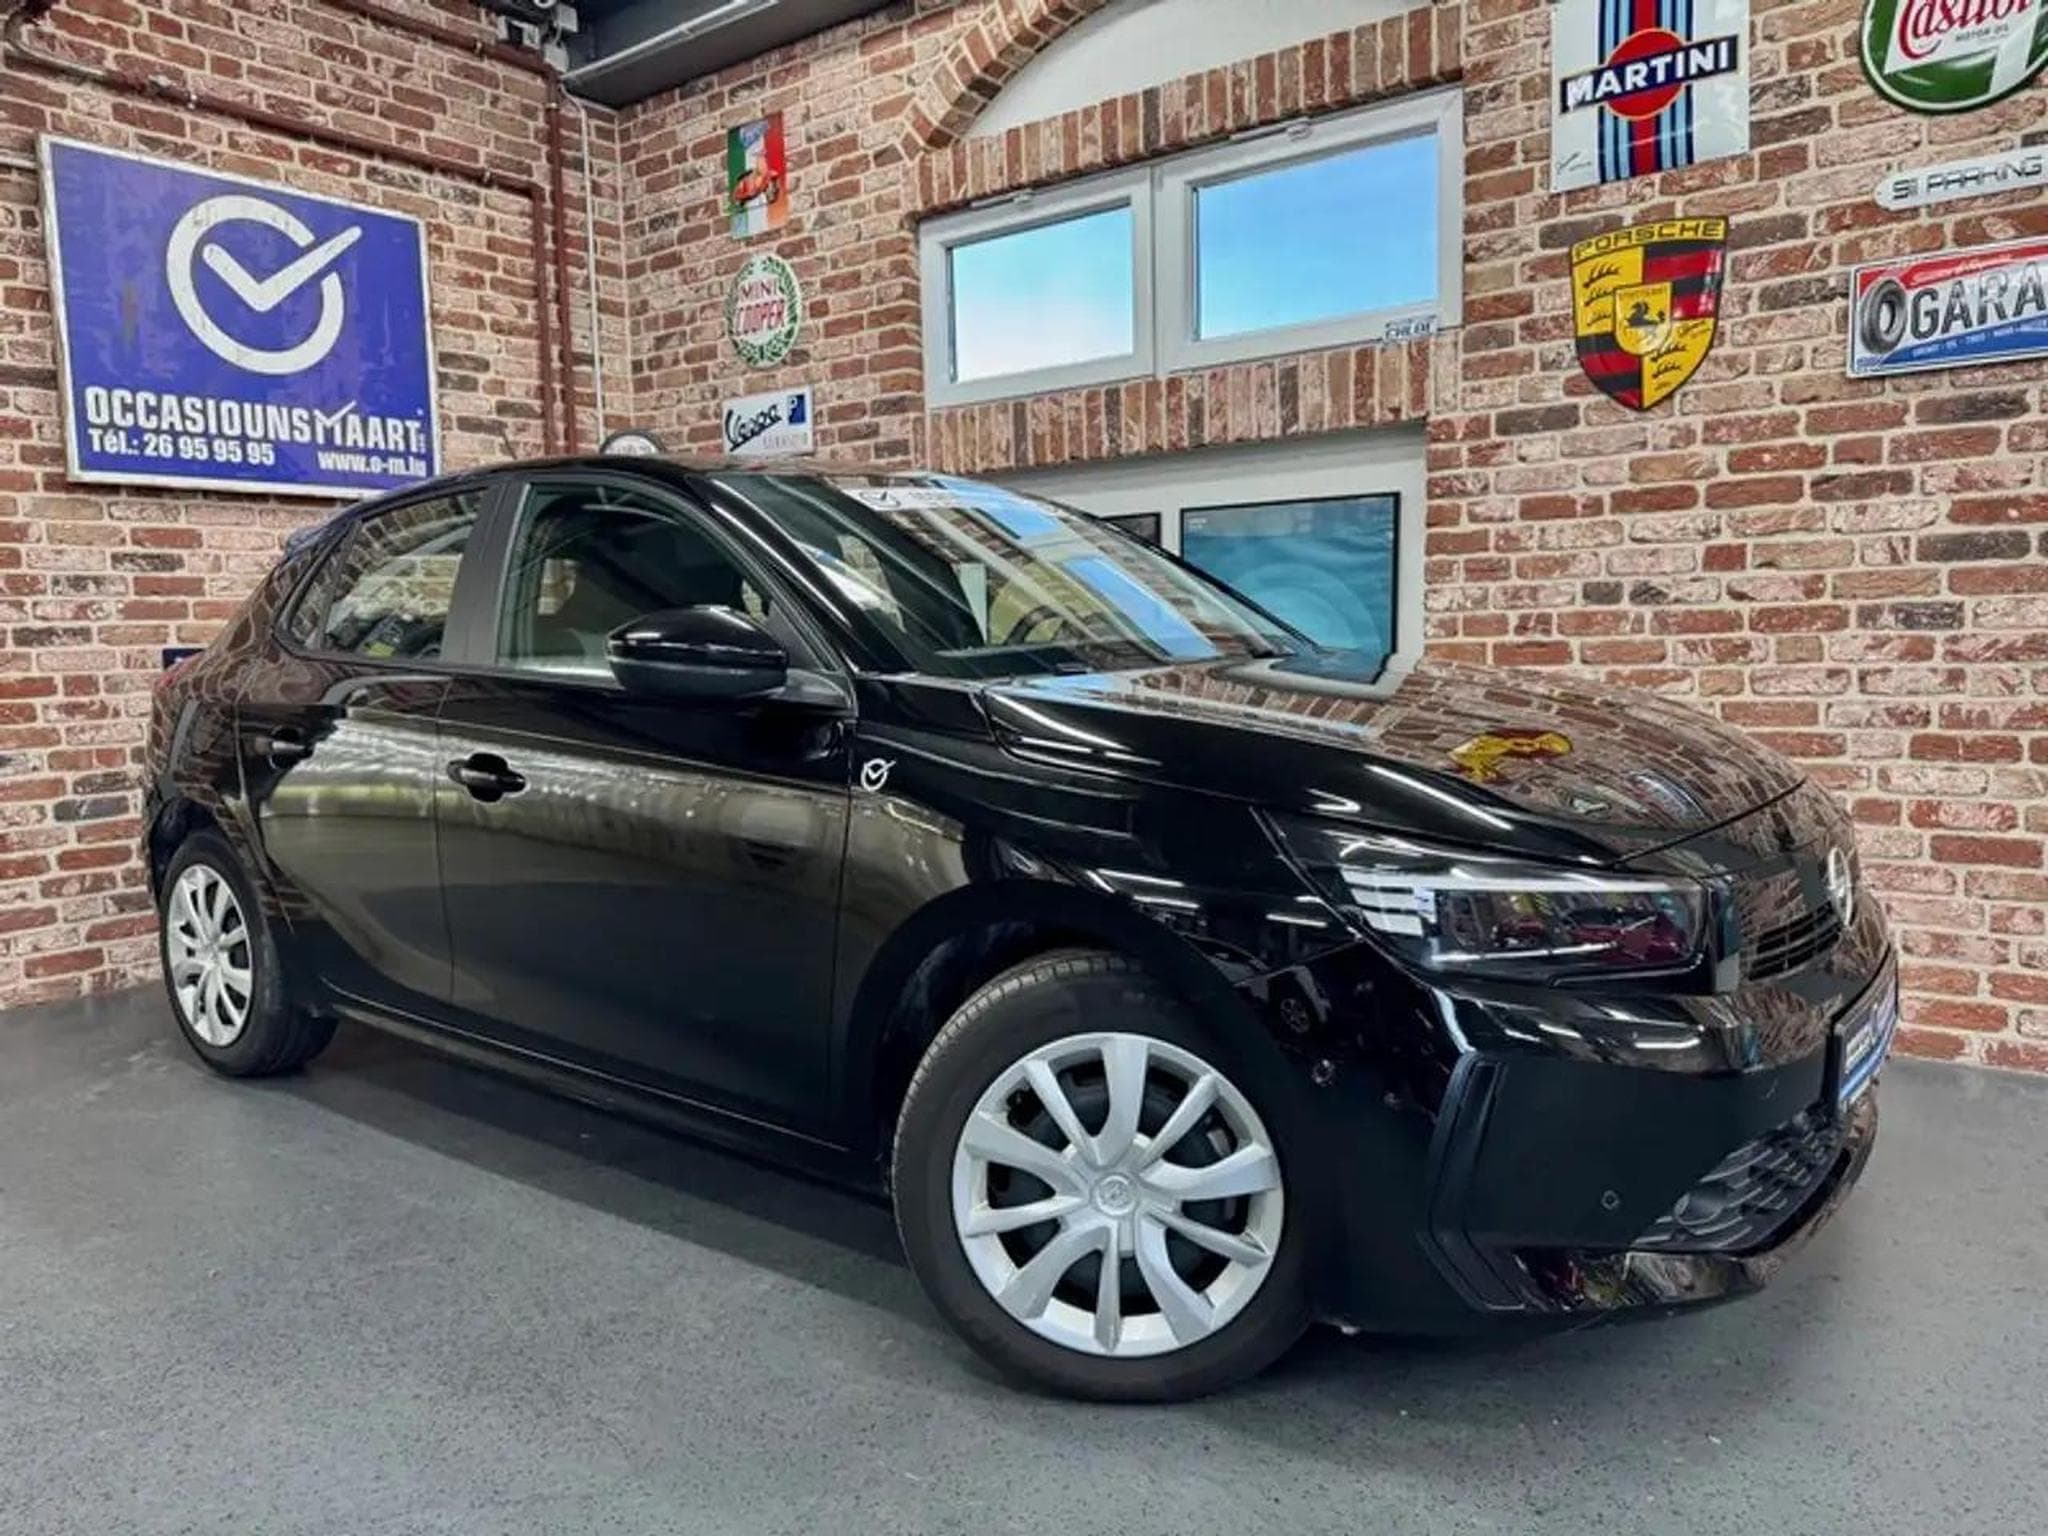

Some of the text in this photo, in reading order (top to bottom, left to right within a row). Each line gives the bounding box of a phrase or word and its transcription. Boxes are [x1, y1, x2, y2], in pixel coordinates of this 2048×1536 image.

[1566, 41, 1730, 105] MARTINI
[1927, 154, 2043, 192] PARKING
[1575, 222, 1722, 259] PORSCHE
[143, 432, 174, 459] 26
[178, 435, 209, 461] 95
[212, 437, 243, 463] 95
[247, 441, 275, 466] 95
